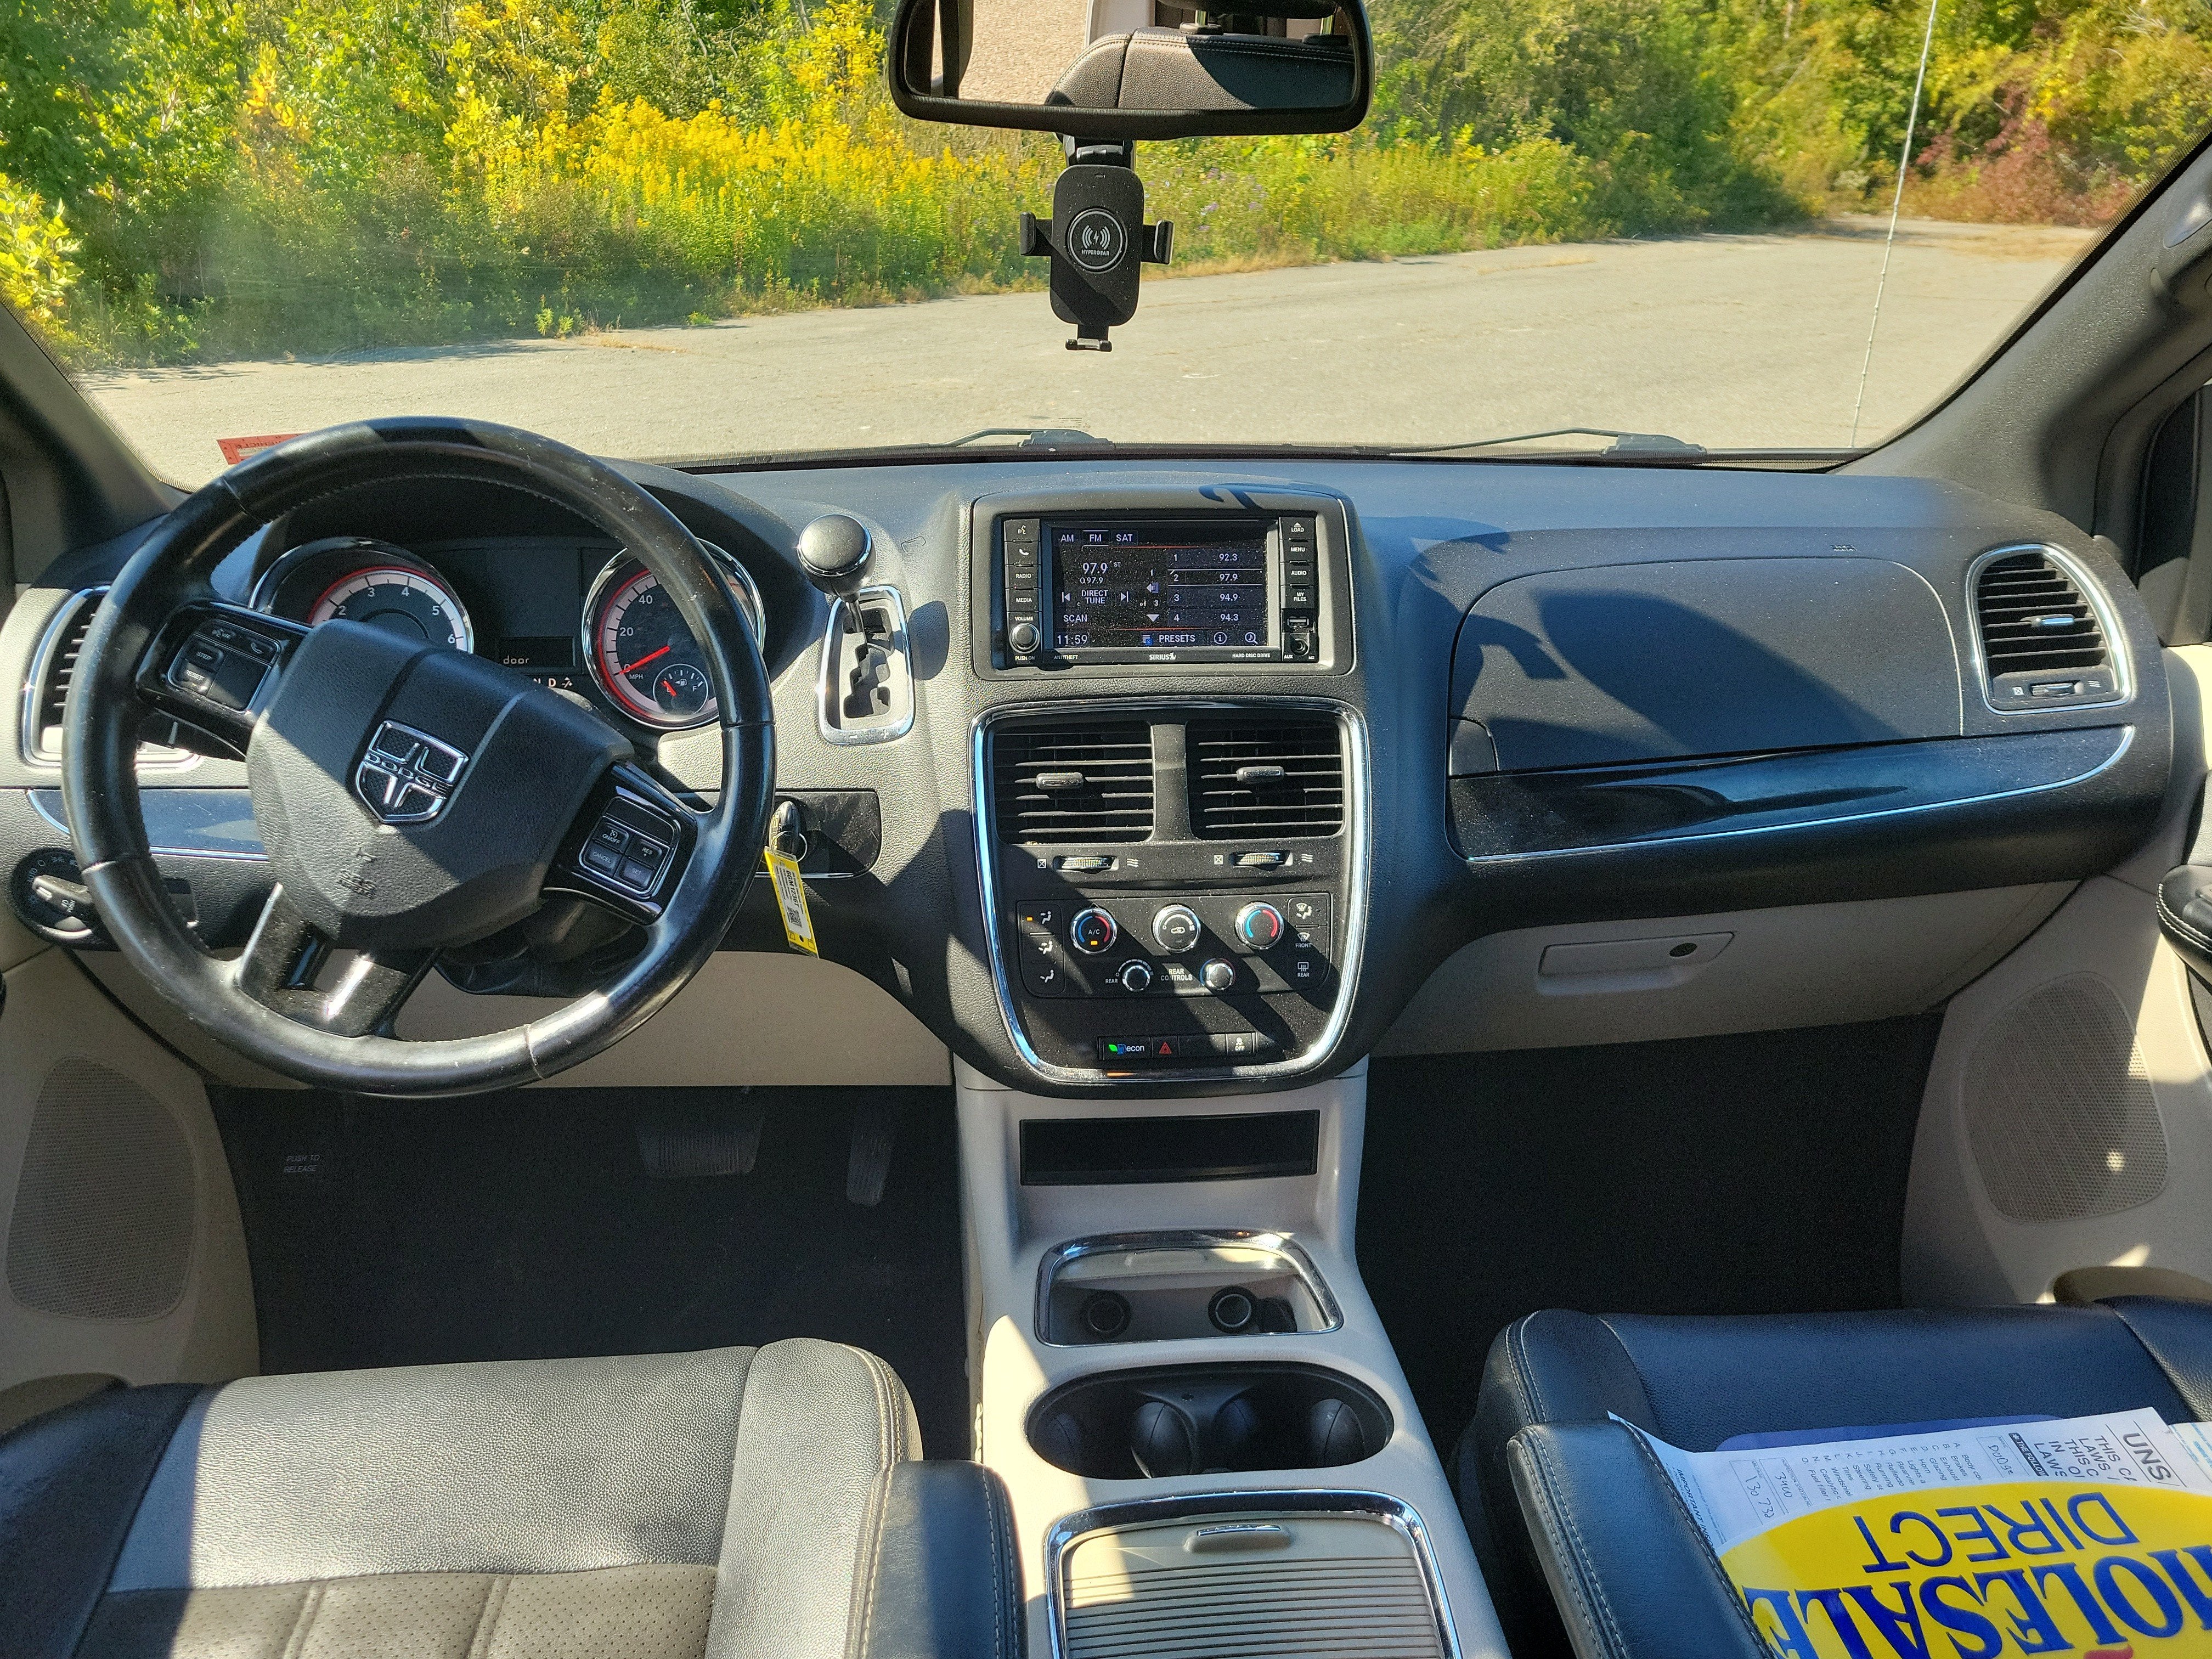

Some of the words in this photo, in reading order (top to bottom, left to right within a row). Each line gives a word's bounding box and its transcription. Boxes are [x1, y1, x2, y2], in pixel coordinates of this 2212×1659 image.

[1060, 534, 1074, 543] AM
[1089, 534, 1102, 542] FM
[1116, 534, 1133, 542] SAT
[1219, 553, 1238, 561] 92.3
[1082, 562, 1108, 574] 97.9
[368, 587, 375, 597] 3
[401, 586, 409, 597] 4
[639, 595, 653, 605] 40
[1173, 594, 1180, 602] 3
[338, 605, 346, 616] 2
[432, 605, 439, 616] 5
[1063, 614, 1087, 622] SCAN
[1173, 613, 1180, 622] 4
[619, 627, 634, 636] 20
[447, 634, 455, 644] 6
[1057, 634, 1088, 645] 11:59
[196, 651, 213, 661] STEP
[503, 655, 530, 664] door
[548, 678, 557, 687] D
[364, 752, 453, 799] DODGE
[602, 833, 620, 844] ON/OFF
[642, 847, 653, 855] RES
[593, 851, 611, 864] CANCEL
[631, 867, 642, 876] SET
[1126, 1044, 1145, 1052] econ
[284, 1165, 317, 1173] RELEASE
[2017, 1440, 2029, 1453] THE
[2048, 1441, 2066, 1453] IN
[2064, 1438, 2090, 1465] THIS
[2094, 1435, 2121, 1462] THIS
[2034, 1442, 2068, 1477] LAWS
[2078, 1437, 2111, 1471] LAWS
[2123, 1432, 2180, 1486] UNS
[1908, 1460, 1922, 1479] Lights
[1917, 1459, 1931, 1474] Horn
[1929, 1458, 1948, 1481] Glazing
[1940, 1457, 1960, 1481] Exhaust
[1951, 1455, 1968, 1477] Brakes
[1961, 1454, 1976, 1470] Body
[1973, 1471, 1982, 1480] co
[1842, 1466, 1854, 1481] Tires
[1853, 1464, 1871, 1490] Steering
[1864, 1463, 1878, 1483] Safety
[1874, 1462, 1894, 1487] Running
[1886, 1462, 1904, 1487] Reflecto
[1896, 1461, 1915, 1486] Rearvie
[1808, 1469, 1821, 1485] Fuel
[1817, 1484, 1829, 1498] filler
[1820, 1469, 1839, 1496] Catalytic
[1677, 1469, 1704, 1523] IMPORTANT
[1853, 1492, 2140, 1573] DIRECT
